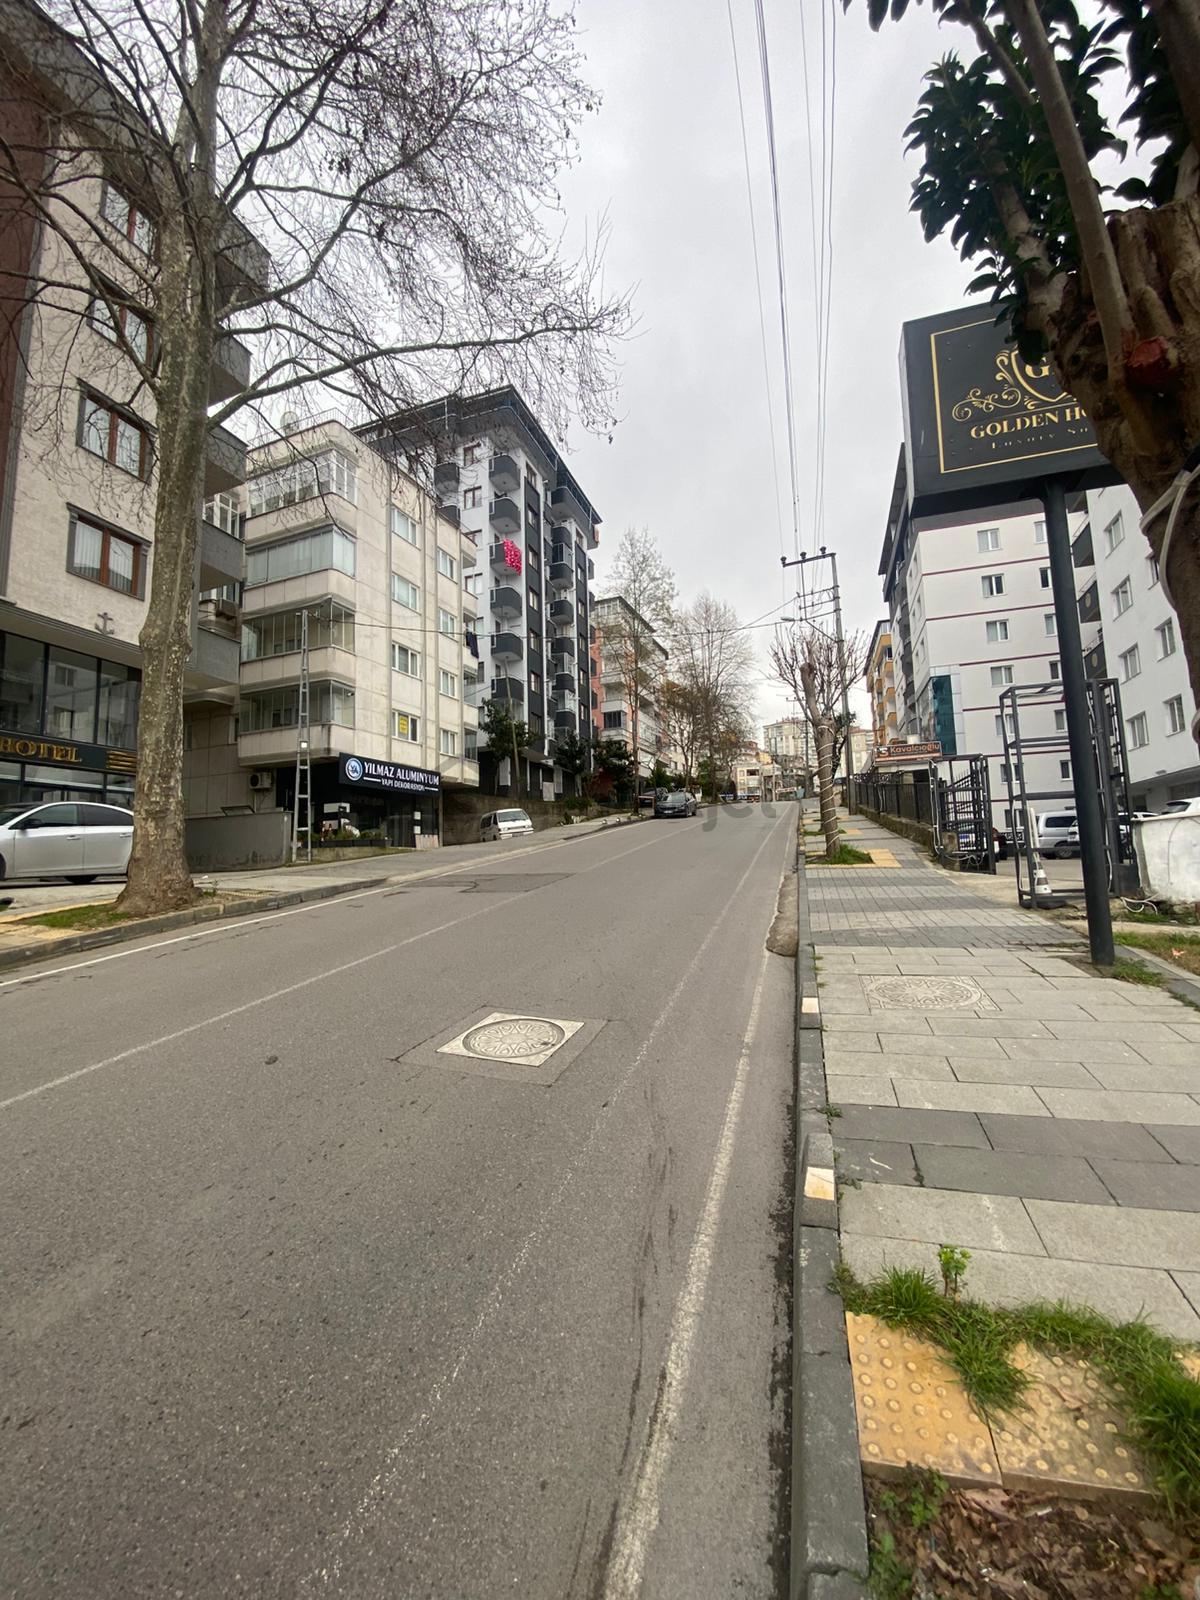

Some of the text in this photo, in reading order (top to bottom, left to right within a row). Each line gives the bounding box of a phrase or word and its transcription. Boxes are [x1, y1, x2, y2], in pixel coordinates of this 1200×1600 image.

[970, 405, 1087, 439] GOLDEN H
[0, 736, 82, 762] HOTEL
[364, 761, 395, 778] YILMAZ
[381, 778, 425, 792] YAPI DEKORASYON
